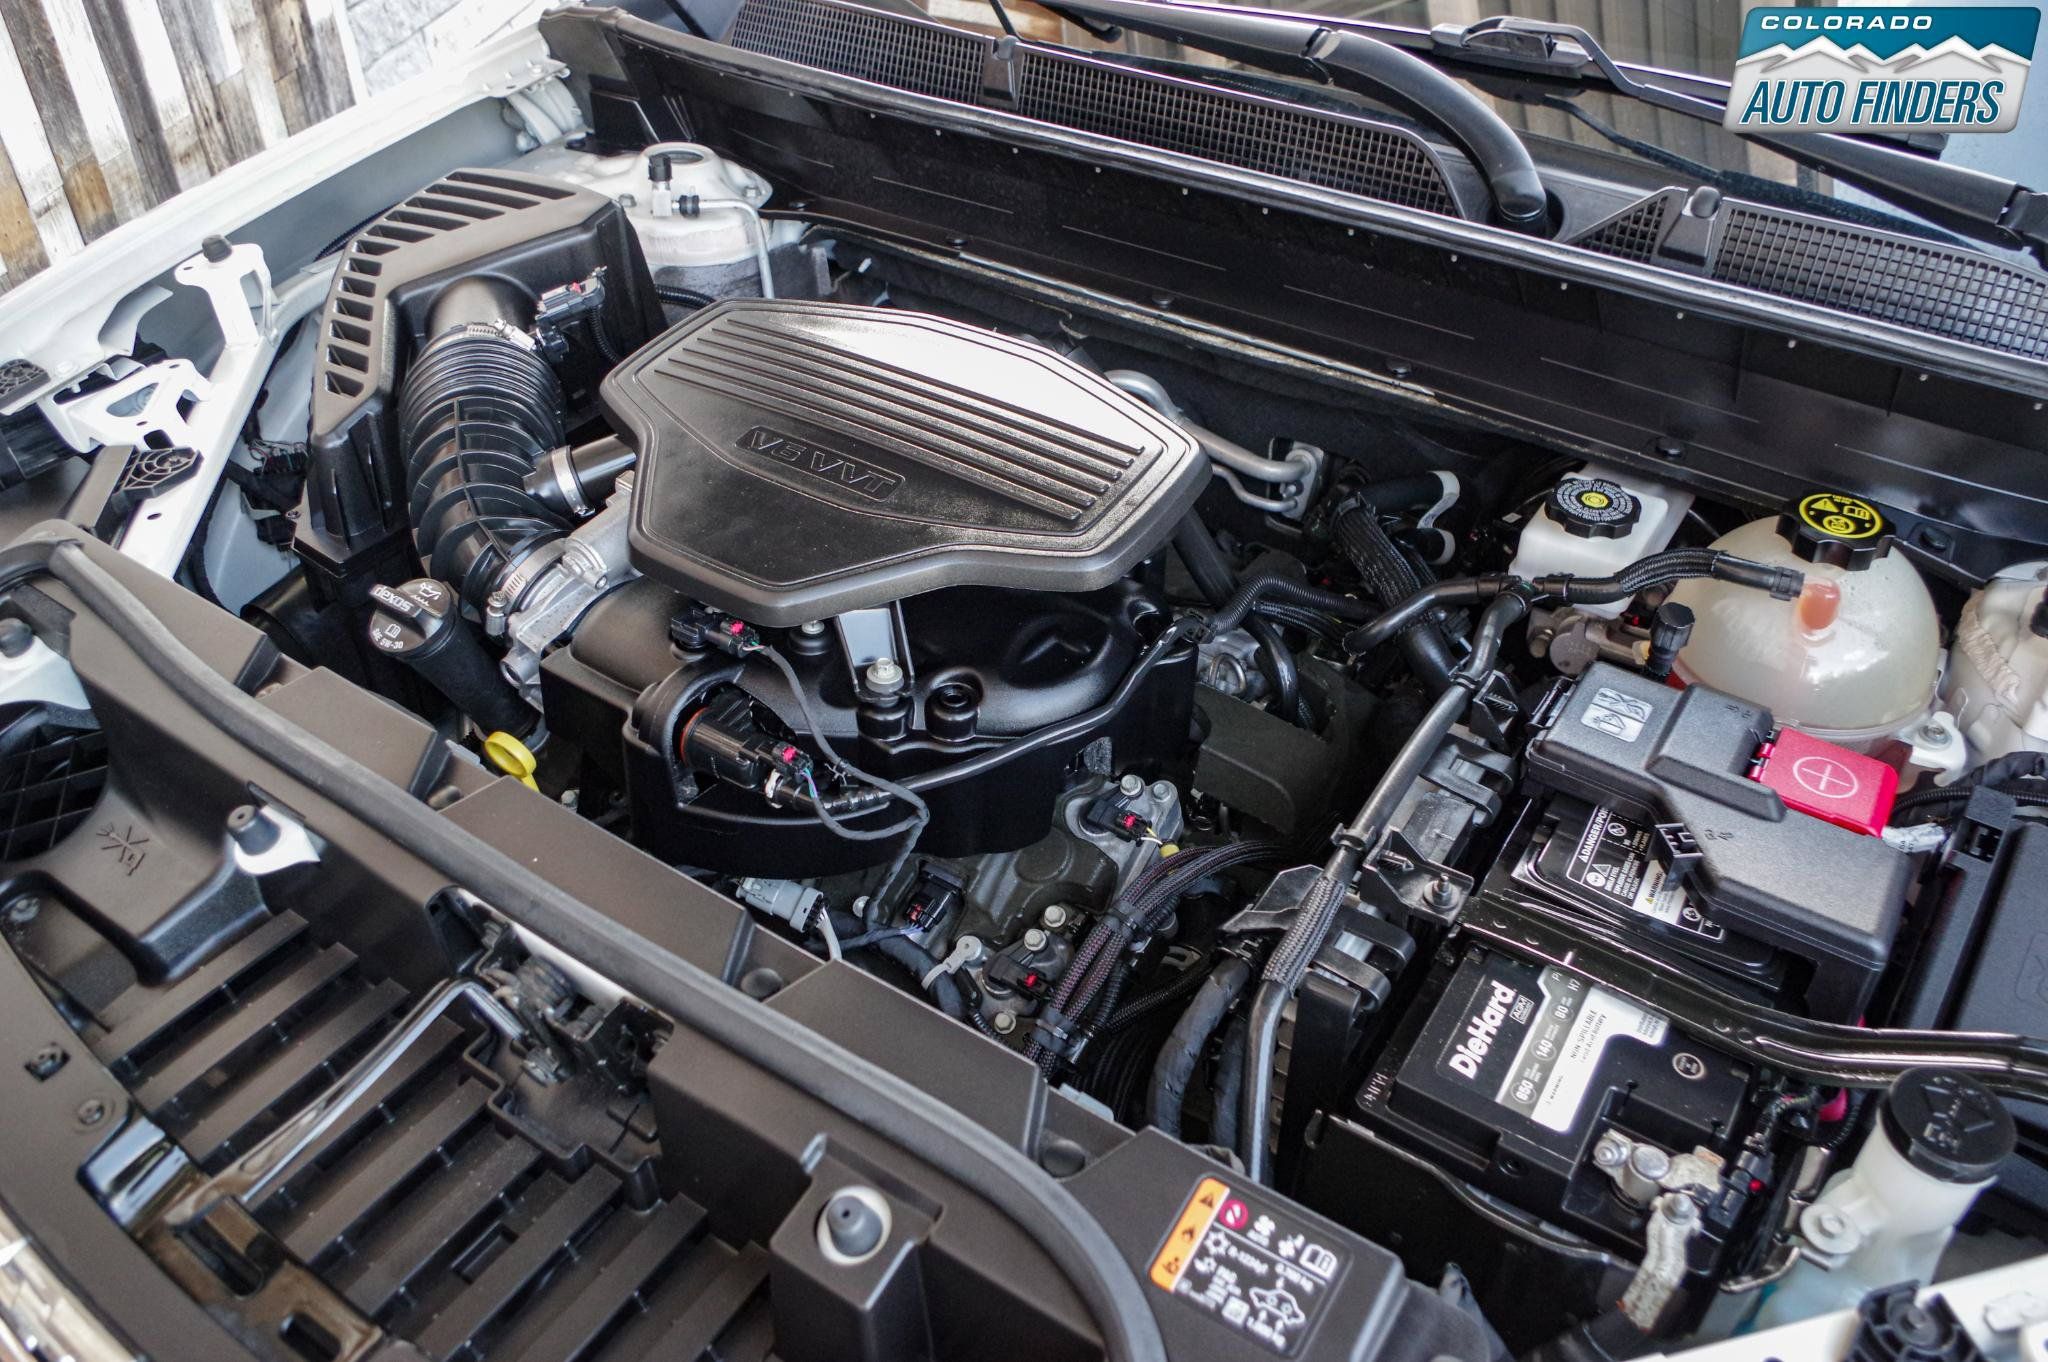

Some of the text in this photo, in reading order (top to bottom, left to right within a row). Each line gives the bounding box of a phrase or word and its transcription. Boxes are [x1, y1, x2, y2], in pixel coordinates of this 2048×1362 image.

[751, 431, 896, 492] V6 VVT
[374, 586, 414, 611] dexos
[380, 638, 403, 649] 5W-30
[1512, 997, 1528, 1019] AGM
[1554, 1005, 1569, 1019] 80
[1449, 980, 1516, 1079] DieHard
[1535, 1038, 1553, 1058] 140
[1515, 1079, 1533, 1101] 850
